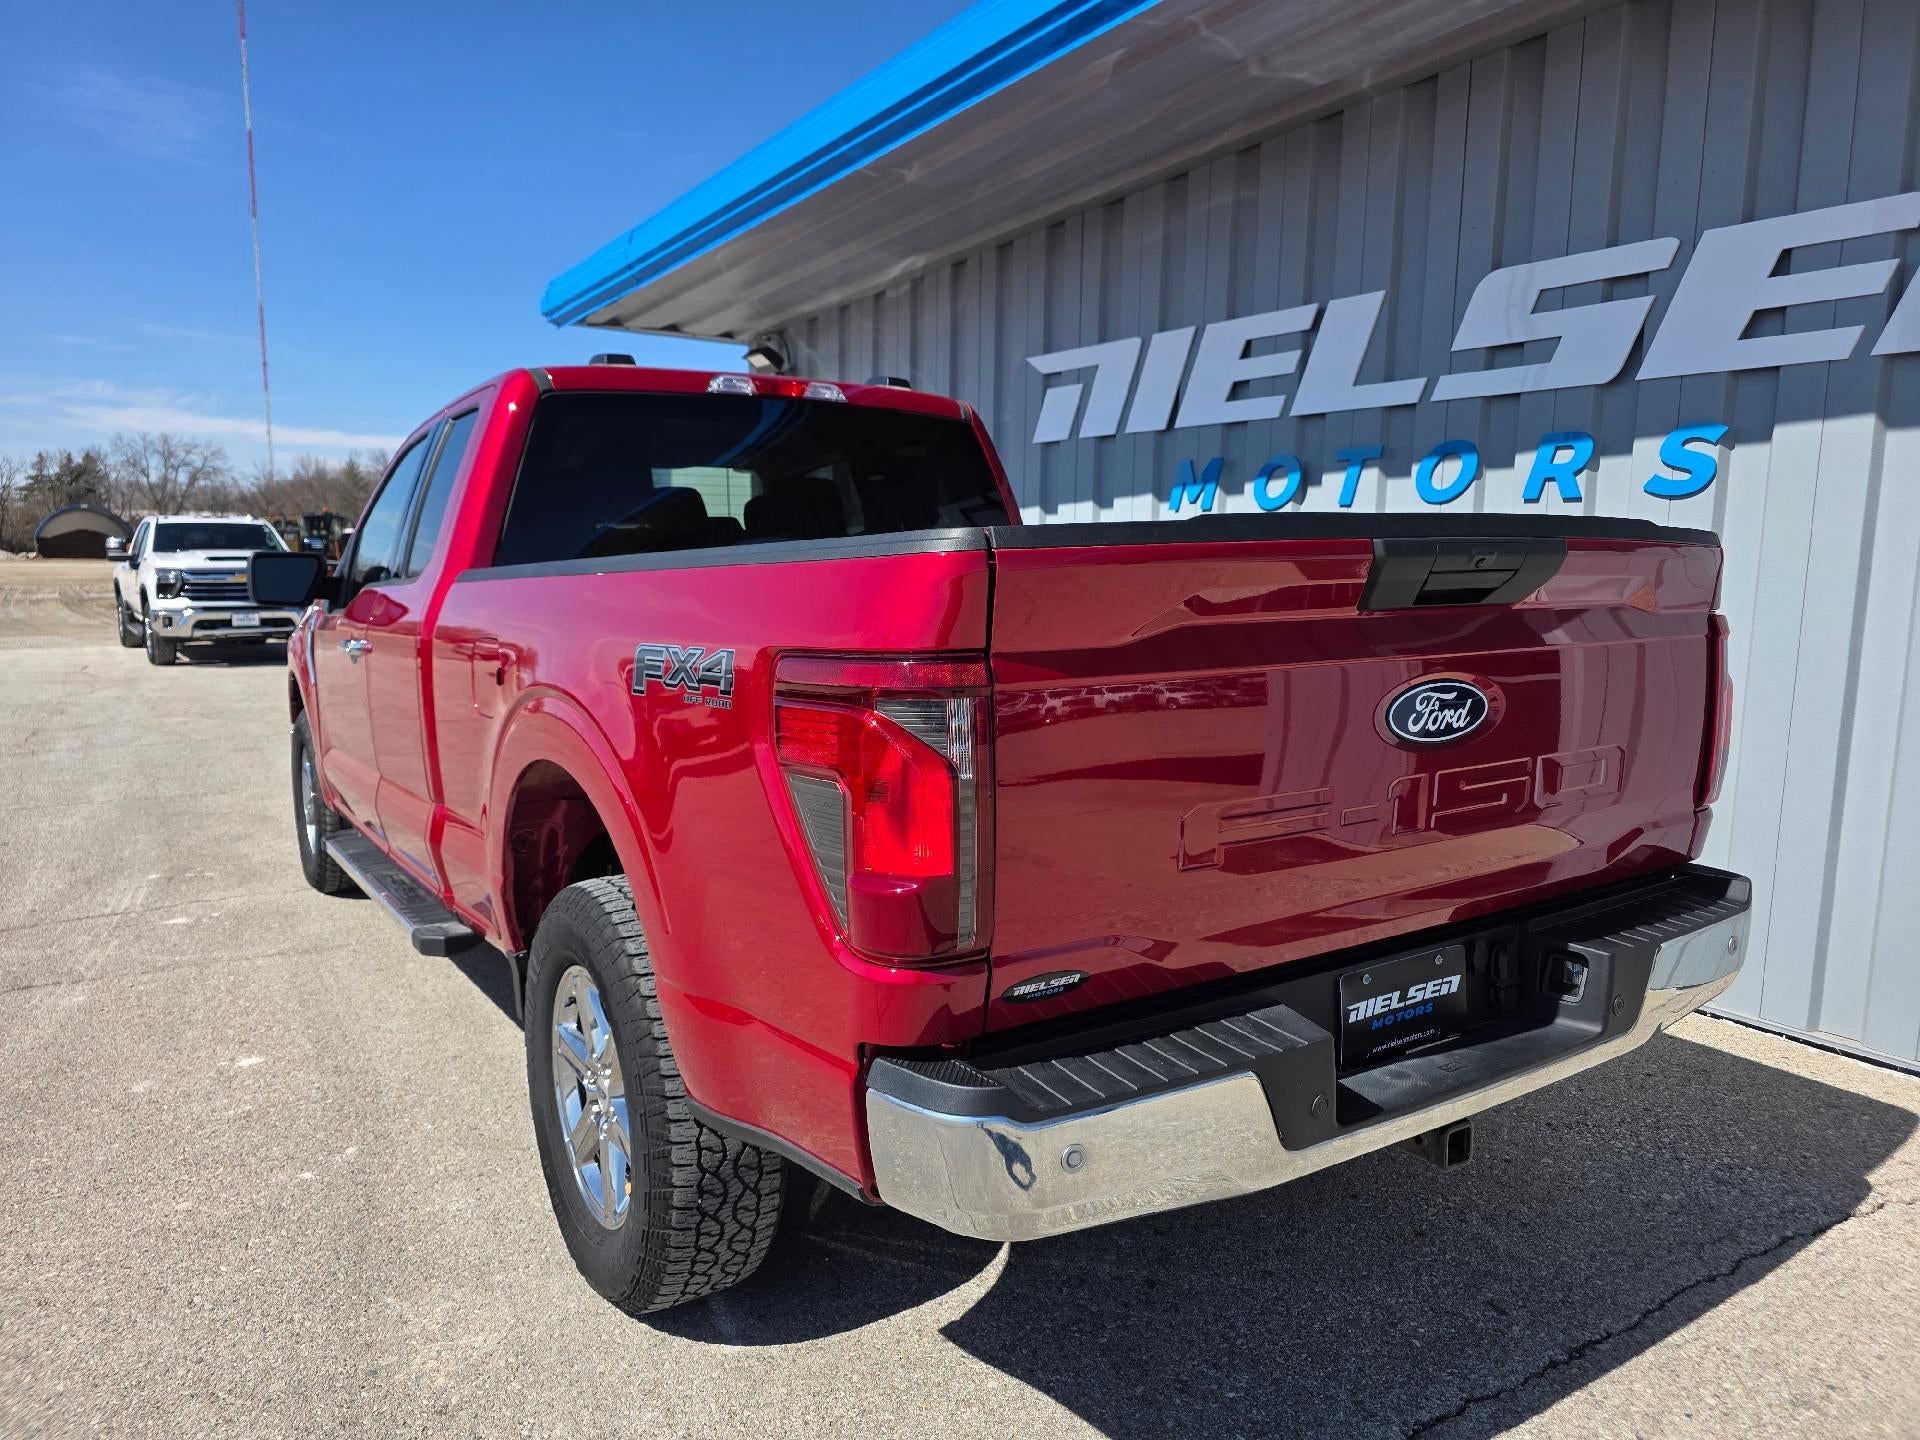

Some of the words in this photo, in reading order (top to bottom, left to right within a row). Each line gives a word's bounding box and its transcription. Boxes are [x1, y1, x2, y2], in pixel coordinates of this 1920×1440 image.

[1027, 191, 1920, 444] NIELSE
[1168, 423, 1730, 513] MOTORS
[632, 643, 736, 697] FX4
[683, 694, 703, 705] OFF
[705, 697, 732, 709] ROAD
[1407, 691, 1475, 734] Ford
[1177, 745, 1625, 873] F-150
[1013, 974, 1081, 996] NIELSEN
[1026, 986, 1064, 999] MOTORS
[1346, 974, 1462, 1024] NIELSEN
[1371, 1002, 1434, 1031] MOTORS
